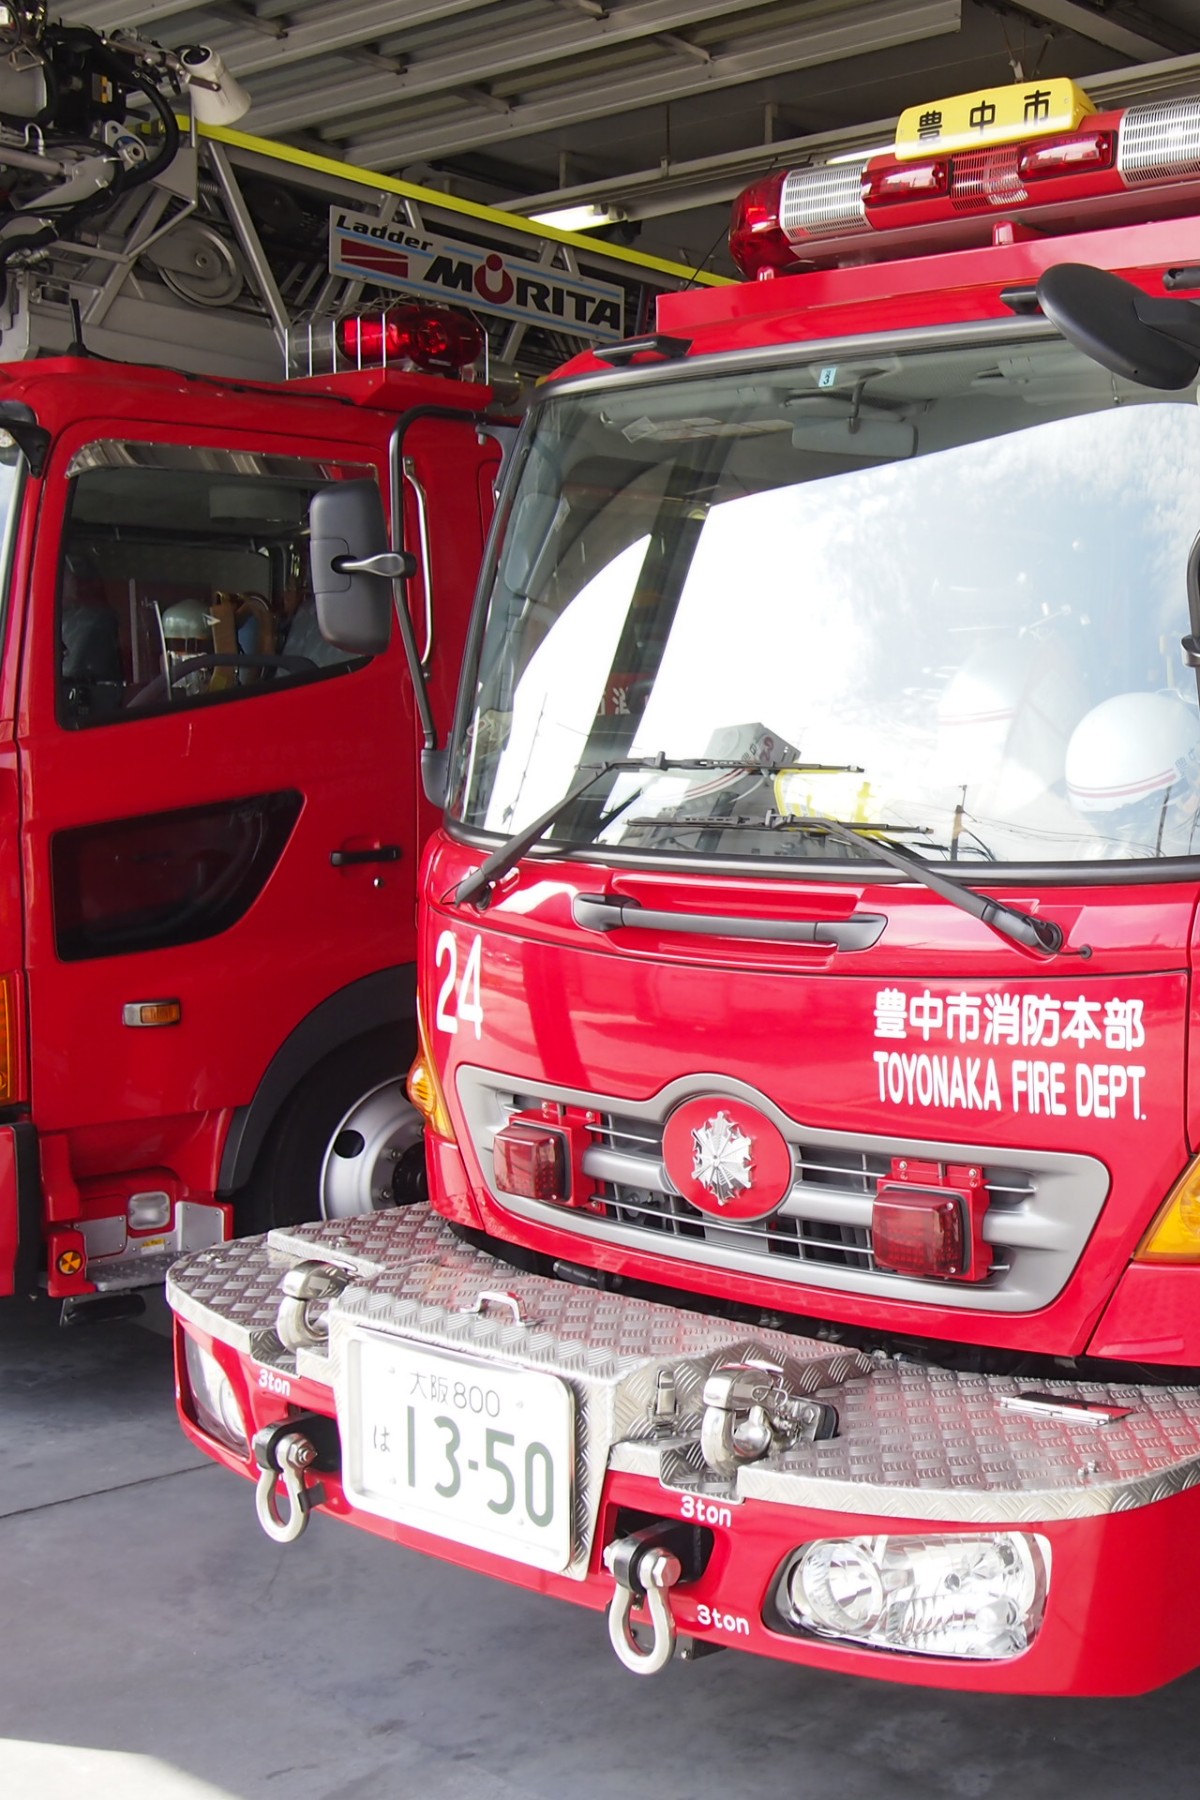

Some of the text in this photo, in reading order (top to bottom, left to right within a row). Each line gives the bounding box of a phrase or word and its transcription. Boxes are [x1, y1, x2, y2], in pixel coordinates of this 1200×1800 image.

[917, 90, 1052, 147] 豊中市
[335, 214, 434, 251] Ladder
[423, 253, 621, 331] MORITA
[435, 929, 484, 1041] 24
[873, 987, 1146, 1051] 豊中市消防本部
[873, 1050, 1147, 1120] TOYONAKA FIRE DEPT.
[258, 1368, 292, 1397] 3ton
[372, 1425, 391, 1452] は
[680, 1495, 732, 1528] 3ton
[696, 1604, 750, 1636] 3ton
